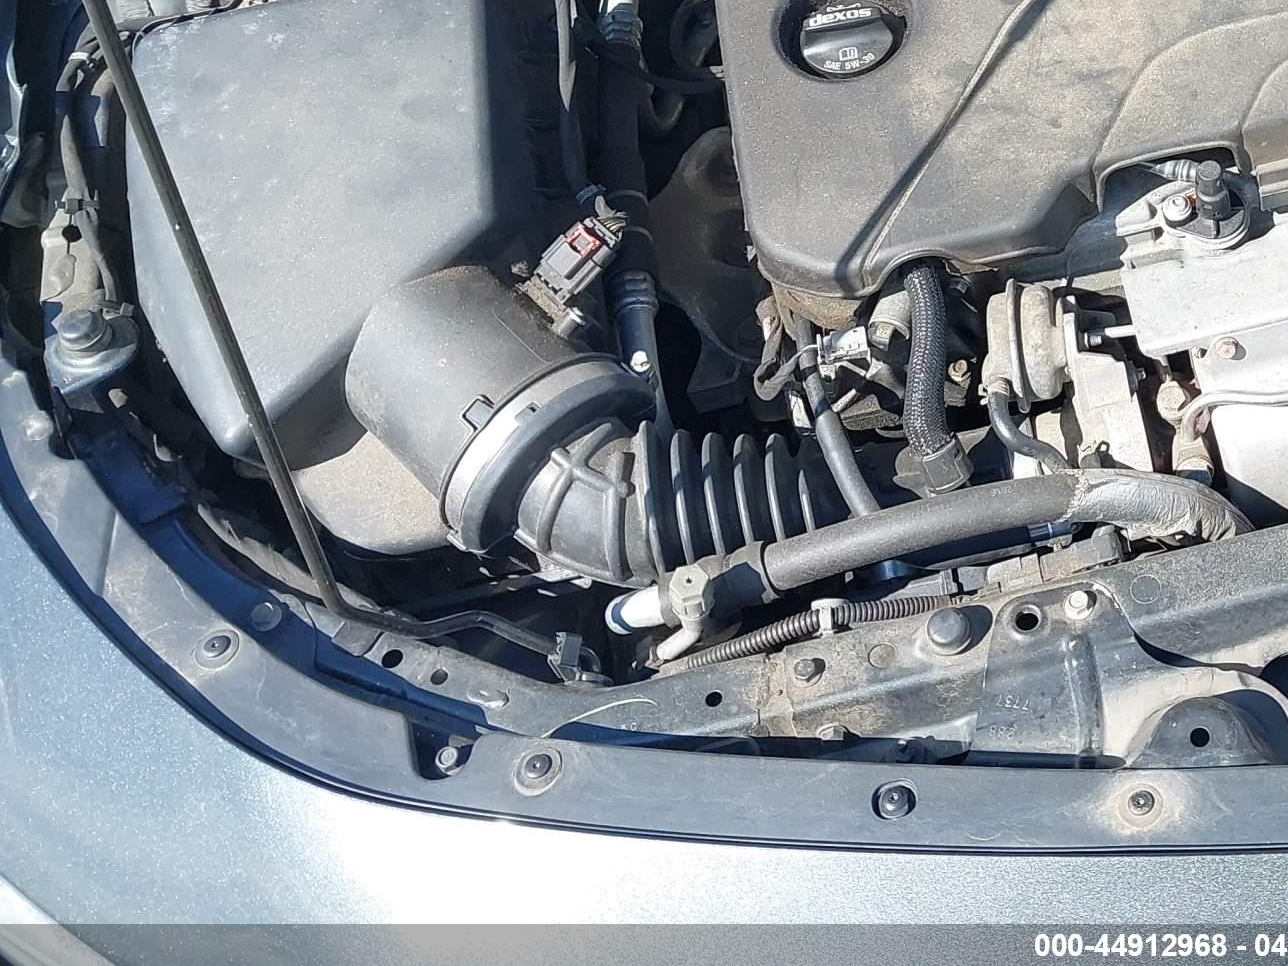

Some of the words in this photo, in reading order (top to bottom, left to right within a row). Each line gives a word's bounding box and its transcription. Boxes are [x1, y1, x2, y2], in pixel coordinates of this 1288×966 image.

[808, 7, 873, 27] dexos
[823, 59, 841, 70] SAE
[844, 52, 875, 70] 5W-30
